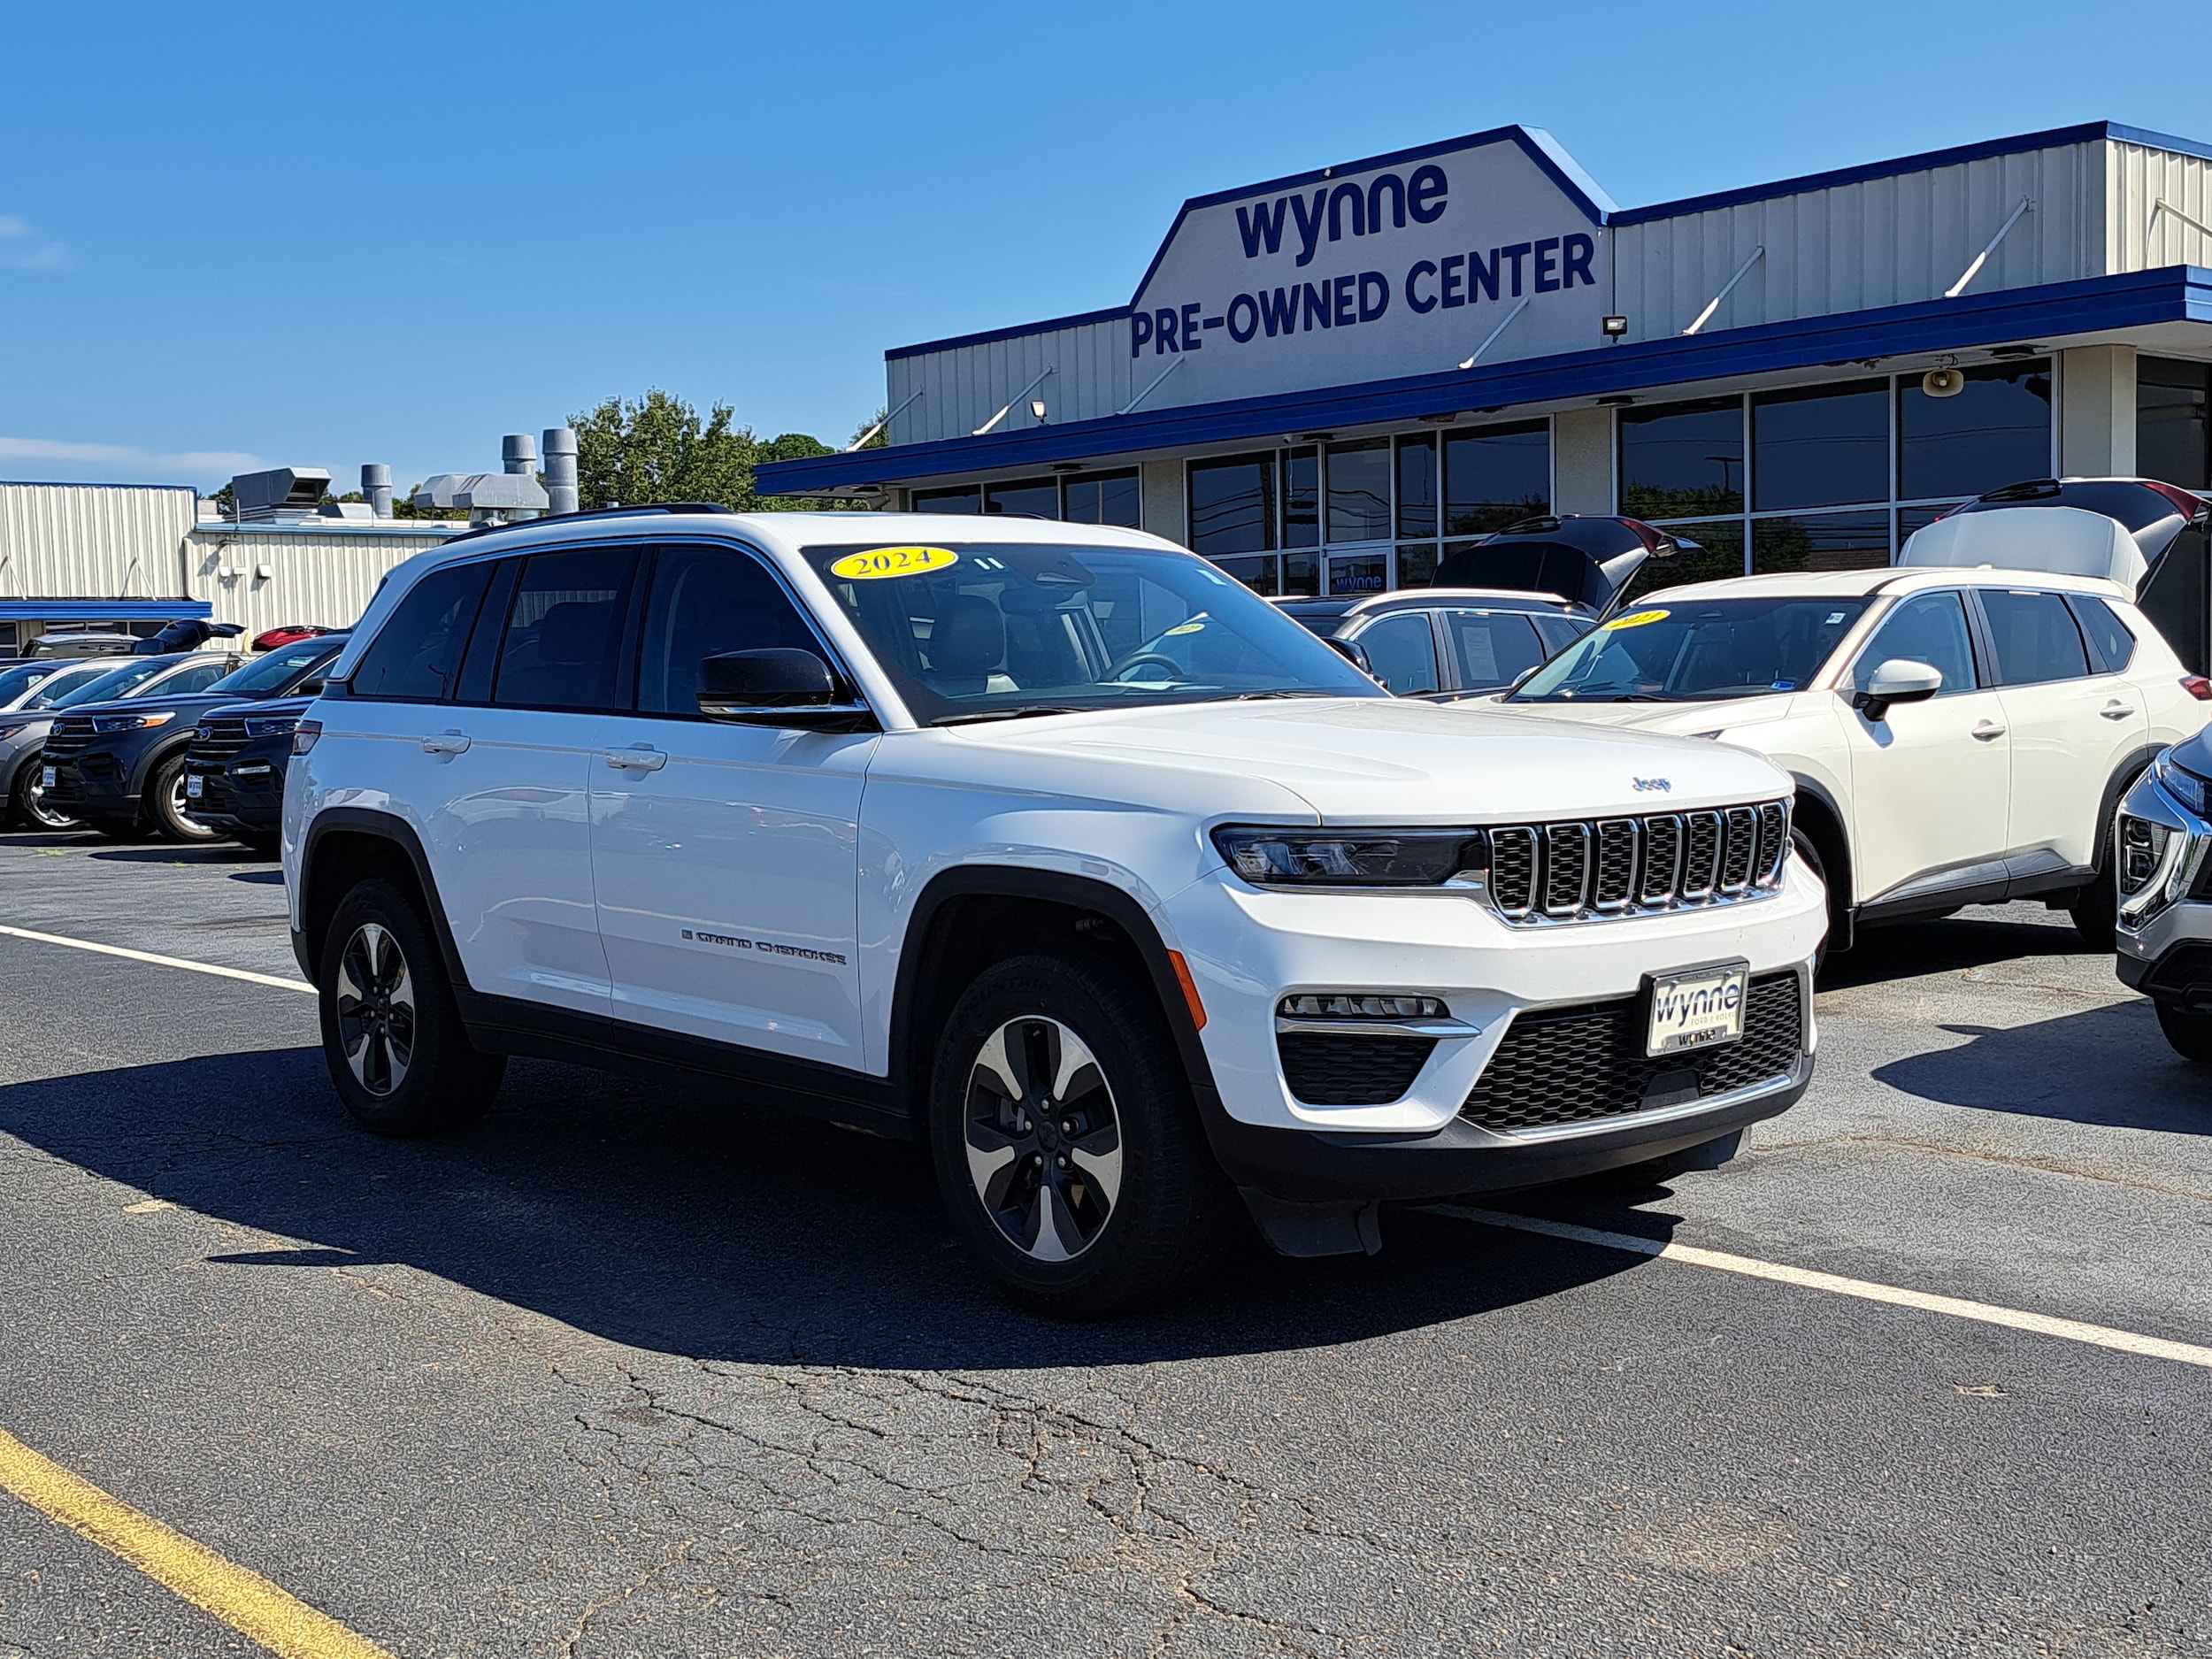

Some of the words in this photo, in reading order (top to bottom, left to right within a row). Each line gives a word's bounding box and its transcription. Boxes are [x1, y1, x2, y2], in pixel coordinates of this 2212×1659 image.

[1236, 164, 1448, 267] wynne
[1132, 270, 1390, 358] PRE-OWNED
[1405, 232, 1596, 314] CENTER
[852, 549, 932, 575] 2024
[1336, 575, 1382, 592] wynne
[1632, 777, 1671, 793] Jeep
[695, 932, 752, 949] GRAND
[756, 941, 847, 965] CHEROKEE
[1657, 984, 1740, 1027] wynne
